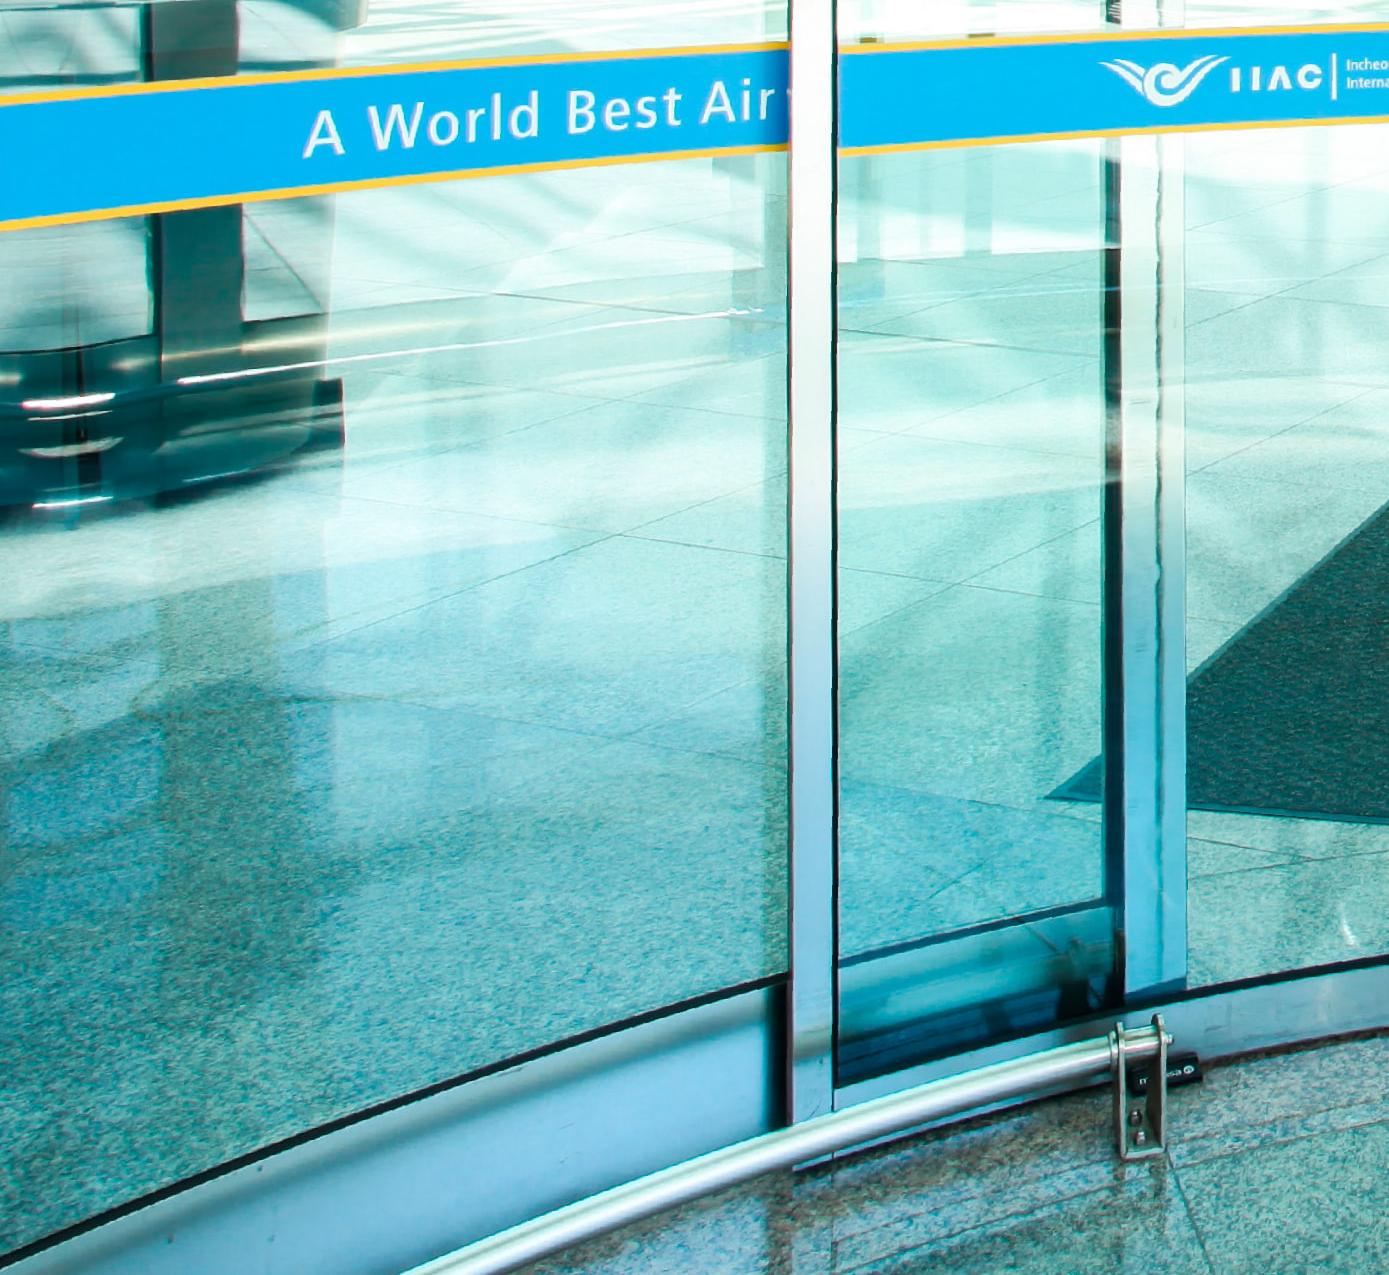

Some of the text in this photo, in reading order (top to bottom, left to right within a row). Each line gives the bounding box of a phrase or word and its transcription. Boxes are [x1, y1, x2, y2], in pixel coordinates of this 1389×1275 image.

[302, 78, 775, 159] A World Best Air
